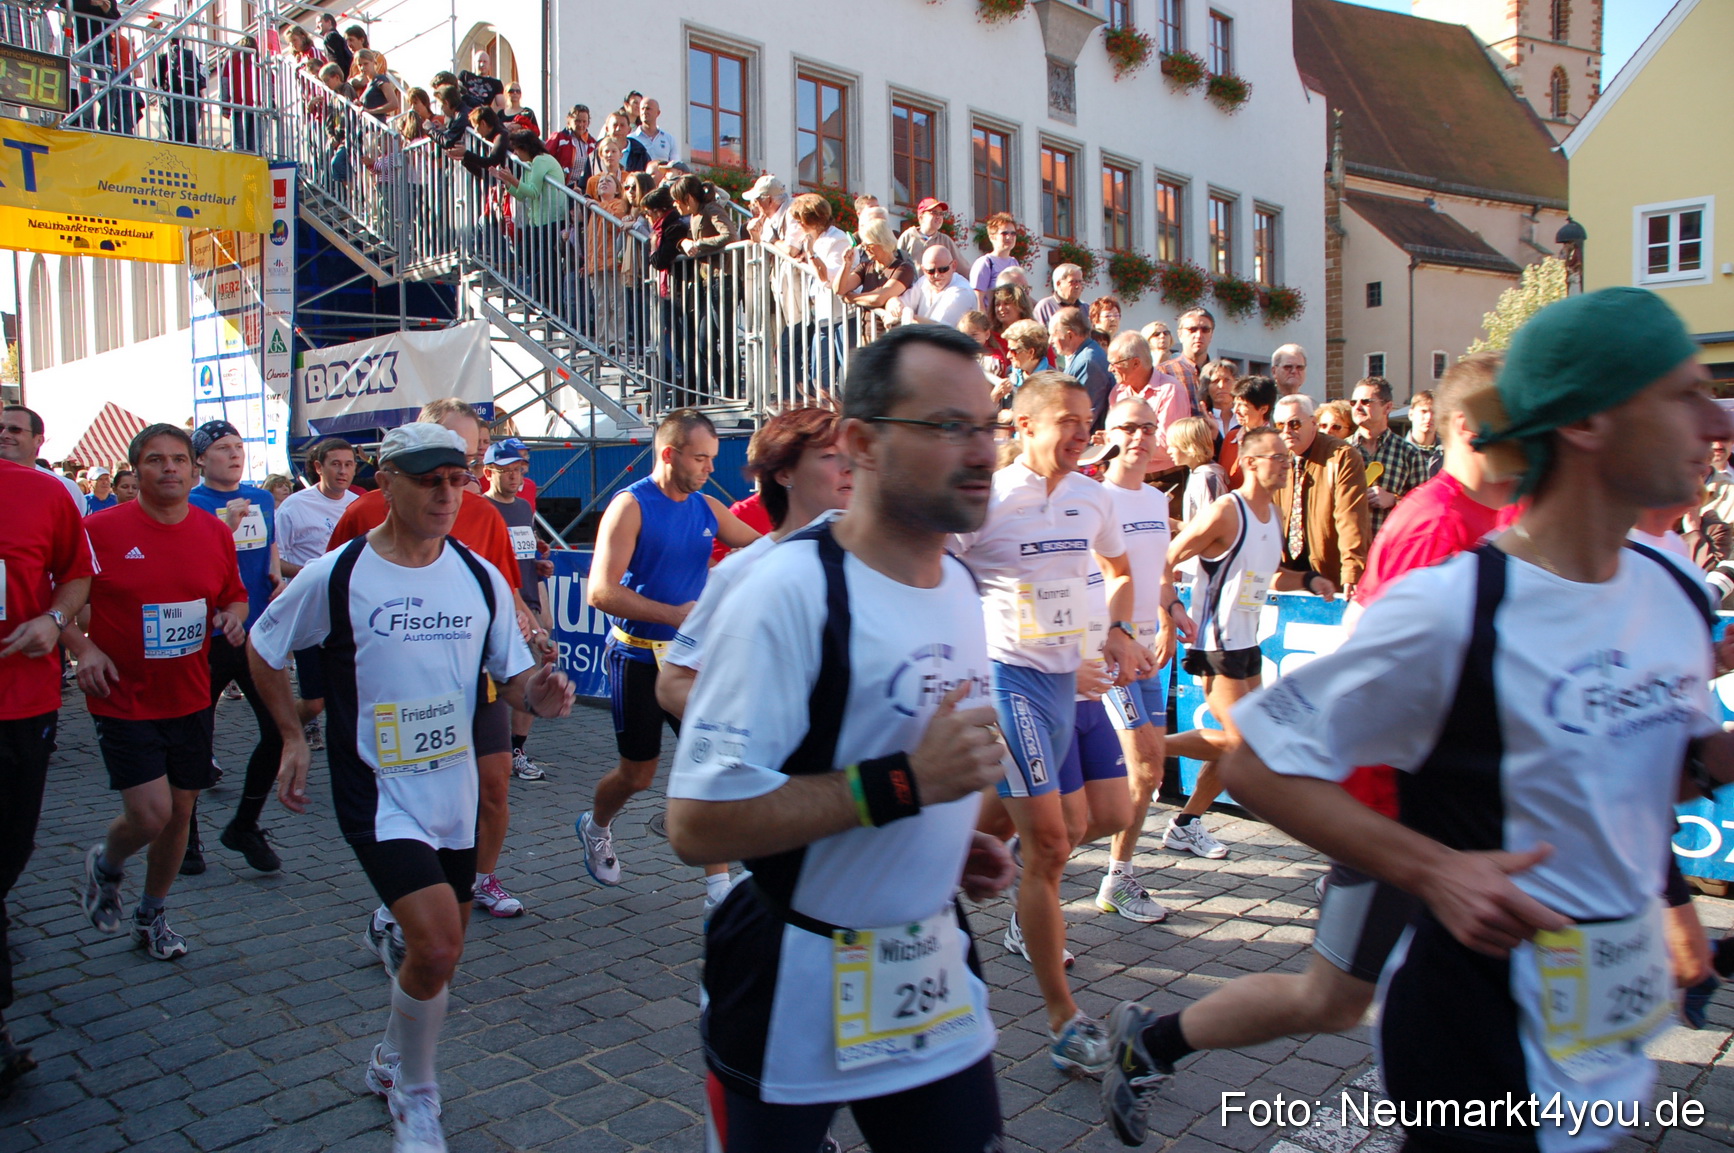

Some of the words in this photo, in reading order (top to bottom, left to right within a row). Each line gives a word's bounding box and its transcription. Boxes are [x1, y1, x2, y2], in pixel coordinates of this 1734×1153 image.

[98, 180, 176, 199] Neumarkter
[180, 190, 236, 206] Stadtlauf
[27, 218, 101, 234] Neumarkter
[101, 226, 154, 239] Stadtlauf
[217, 280, 240, 294] MERZ
[305, 351, 399, 403] BOCK
[243, 524, 257, 537] 71
[517, 541, 536, 550] 3296
[163, 608, 182, 619] Willi
[390, 612, 473, 631] Fischer
[1053, 608, 1073, 627] 41
[166, 623, 202, 643] 2282
[403, 631, 472, 642] Automobile
[402, 700, 455, 723] Friedrich
[381, 733, 388, 744] C
[414, 725, 456, 753] 285
